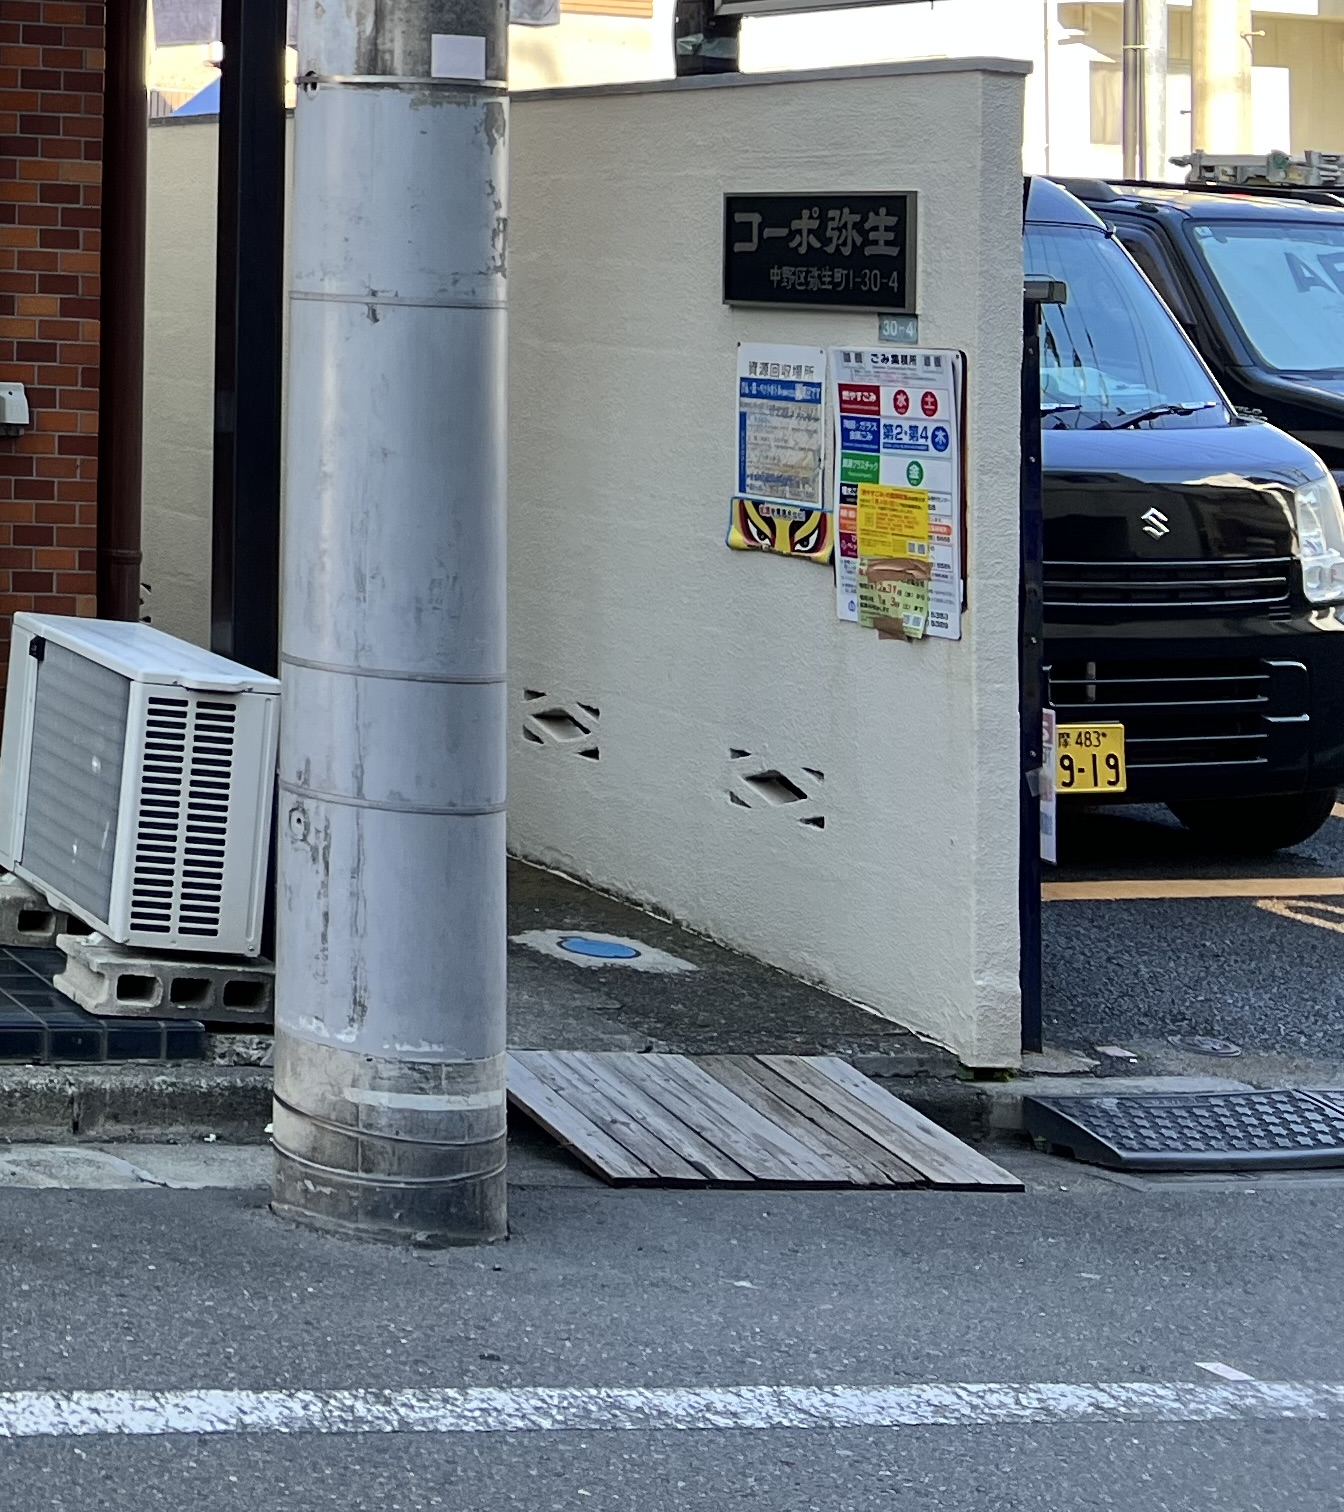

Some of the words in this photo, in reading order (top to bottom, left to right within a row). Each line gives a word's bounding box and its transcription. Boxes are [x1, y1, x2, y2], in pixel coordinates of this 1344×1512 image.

[733, 206, 901, 257] コーポ弥生
[769, 264, 899, 293] 中野区弥生町1-30-4
[882, 319, 914, 337] 30-4
[1075, 730, 1101, 748] 483
